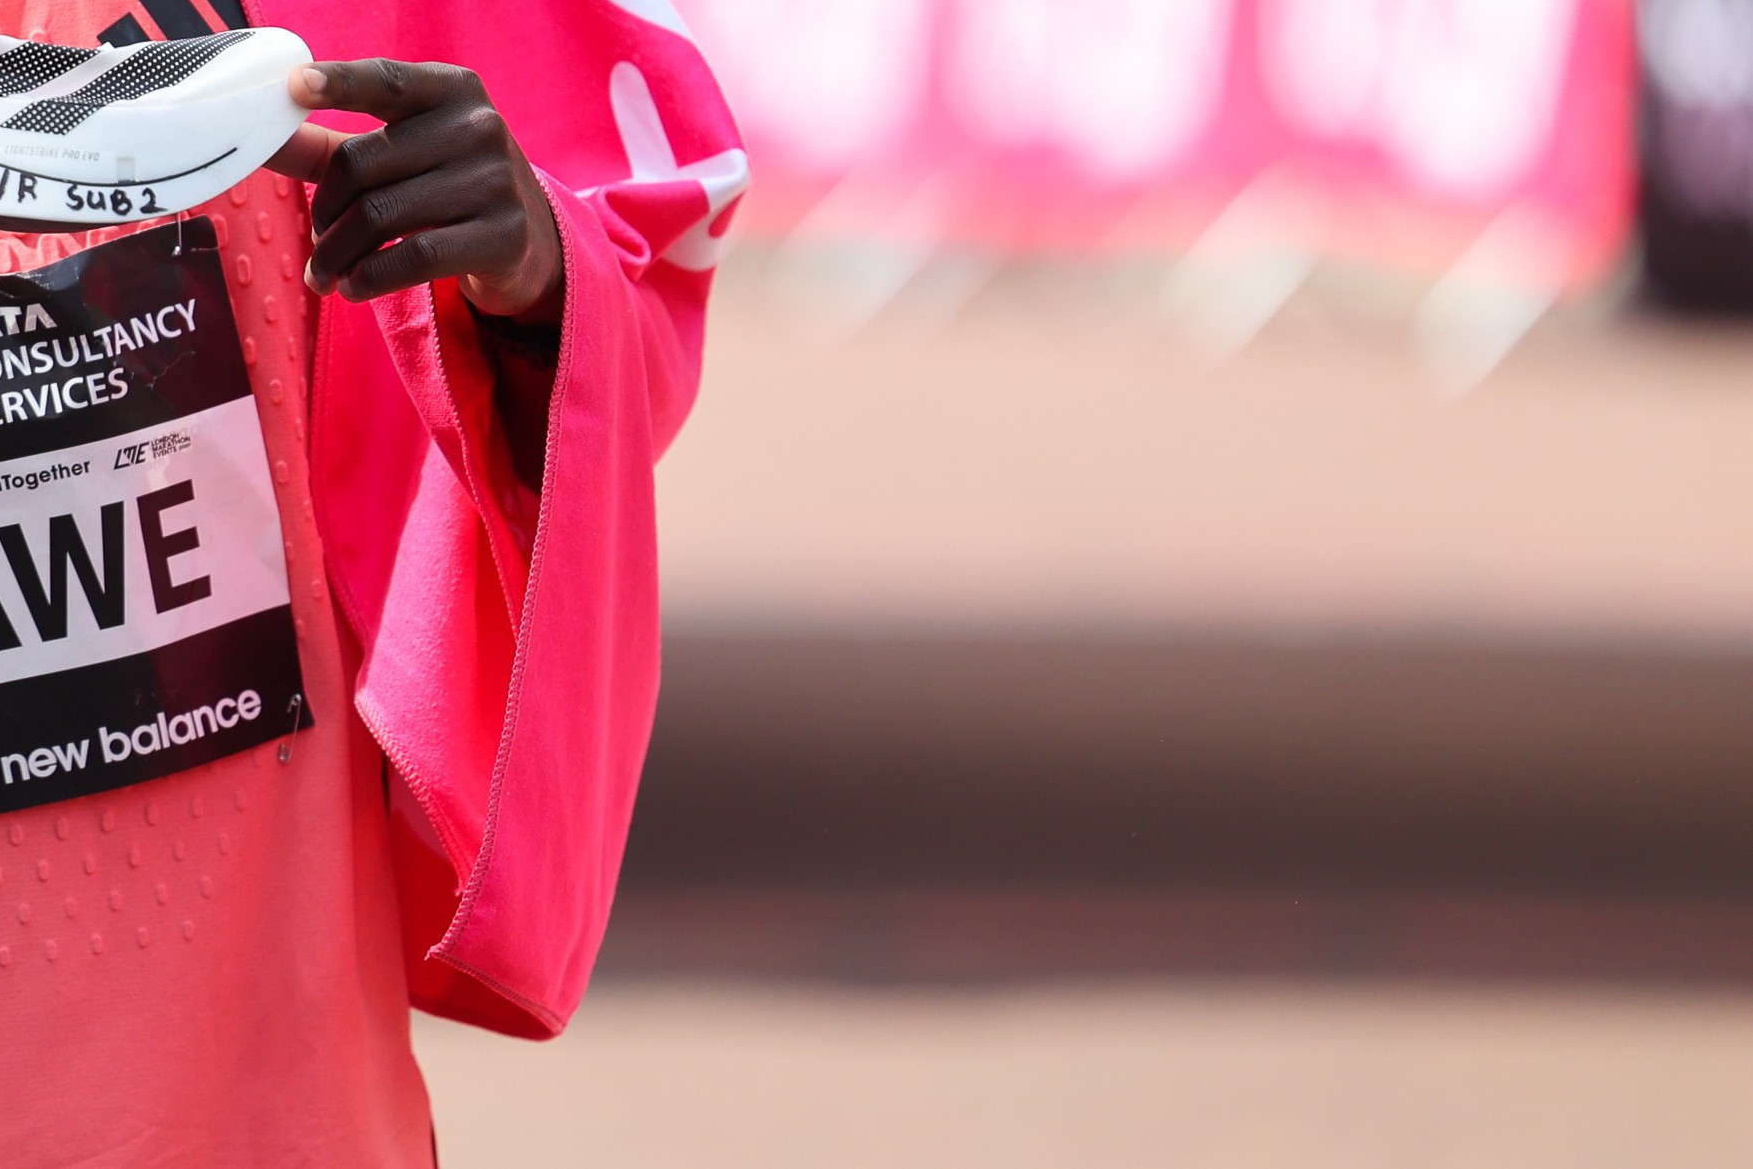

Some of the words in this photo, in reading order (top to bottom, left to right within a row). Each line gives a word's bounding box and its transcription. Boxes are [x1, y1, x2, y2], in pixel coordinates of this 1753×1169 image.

[4, 144, 59, 158] LIGHTSTRIKE
[61, 149, 81, 160] PRO
[0, 739, 90, 785] new
[98, 688, 263, 764] balance
